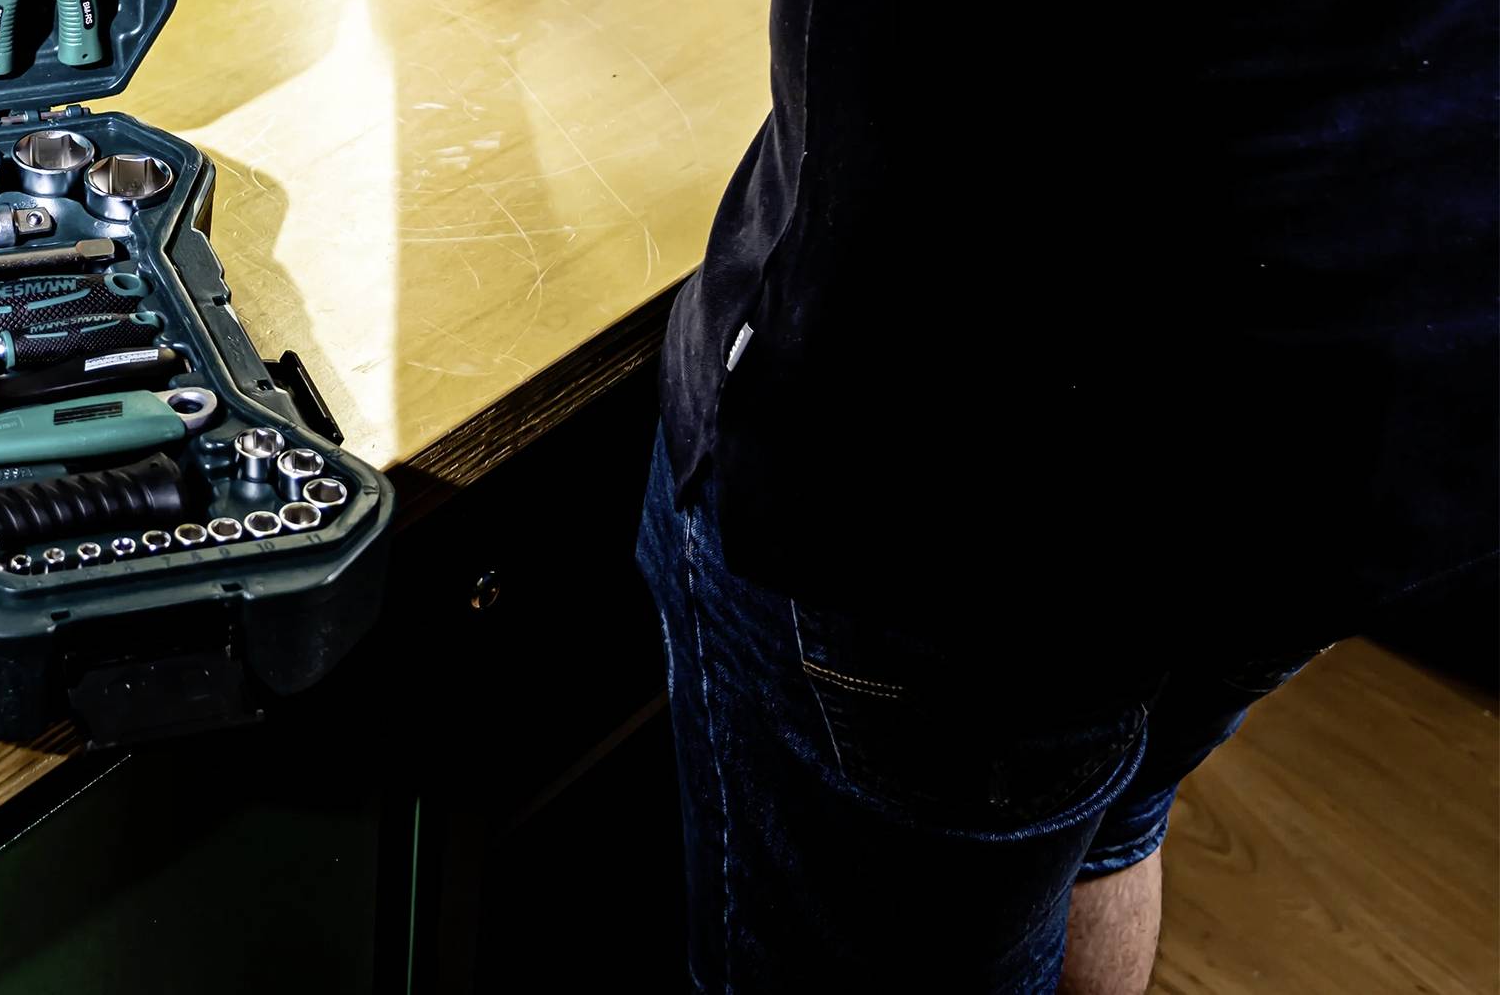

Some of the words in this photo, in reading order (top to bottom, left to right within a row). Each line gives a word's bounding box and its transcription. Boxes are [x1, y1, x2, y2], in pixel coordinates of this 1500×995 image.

[82, 1, 93, 25] BM-RS
[306, 533, 323, 545] 11
[219, 547, 231, 558] 9
[255, 541, 276, 554] 10
